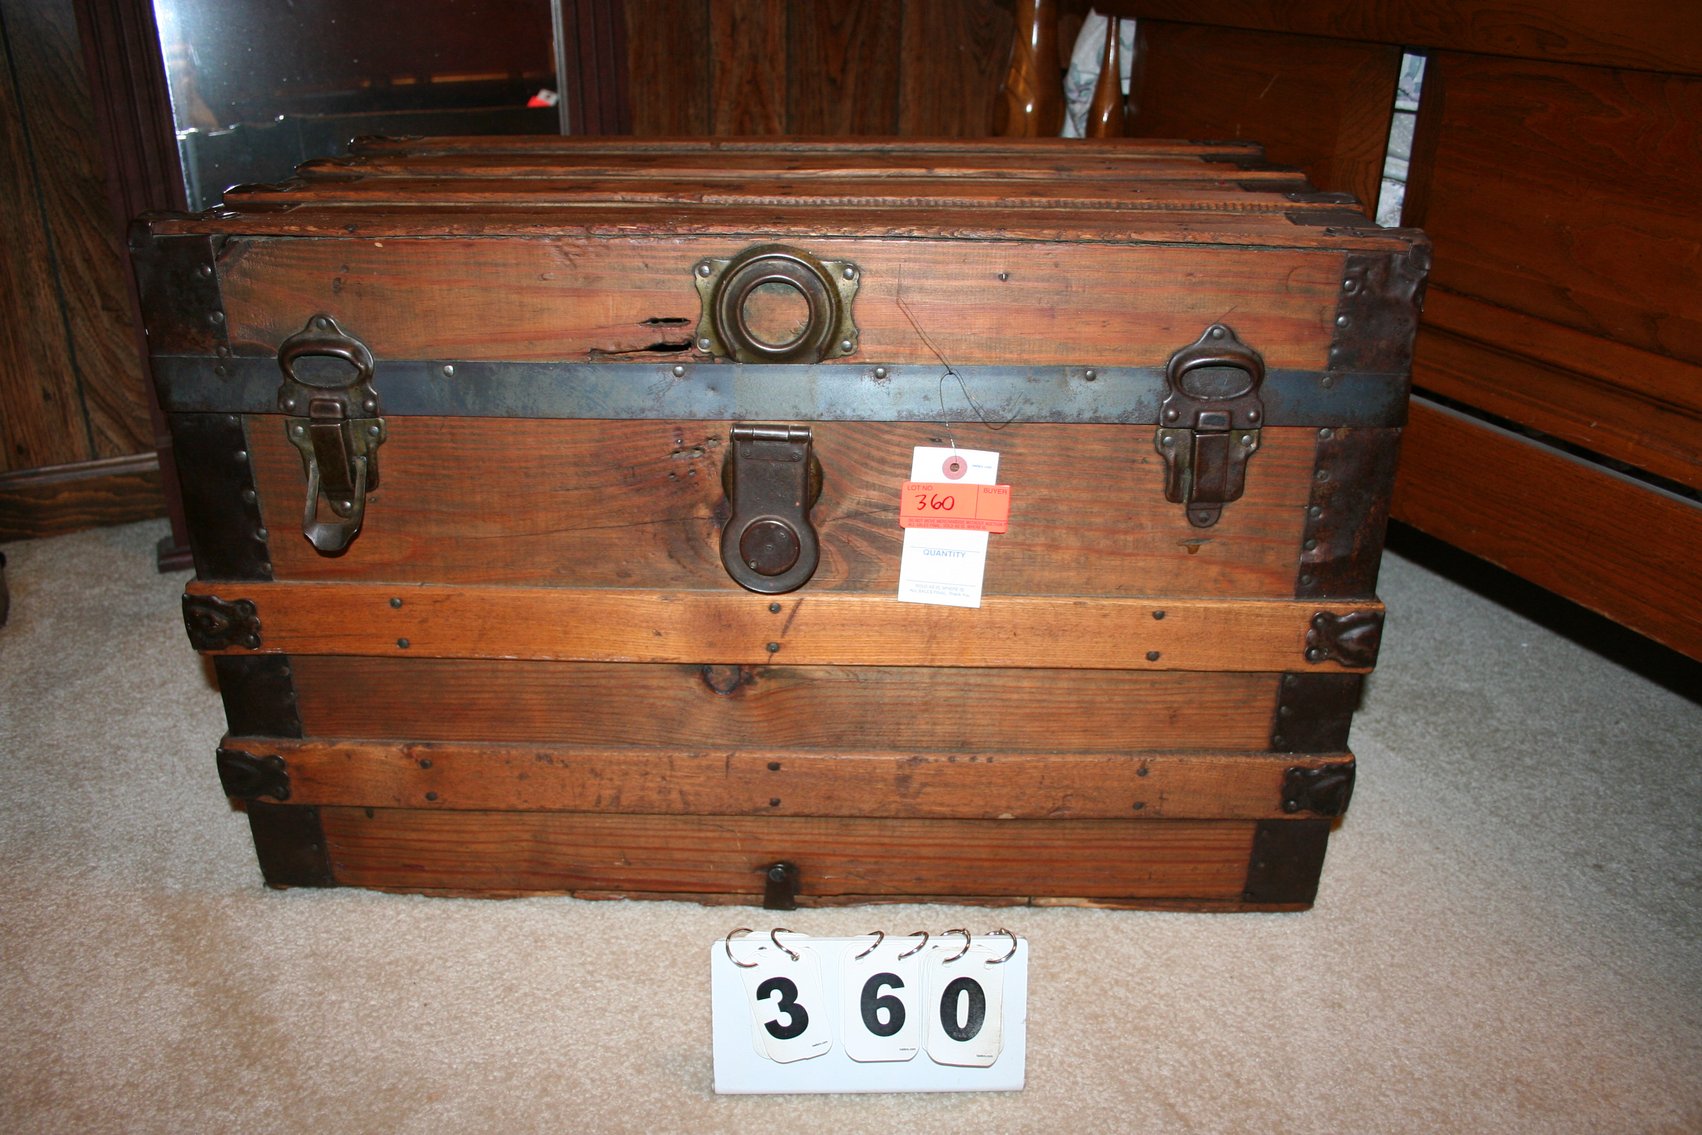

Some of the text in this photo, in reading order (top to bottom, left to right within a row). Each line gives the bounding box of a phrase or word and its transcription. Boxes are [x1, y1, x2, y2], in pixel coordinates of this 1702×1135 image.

[914, 493, 955, 511] 360
[923, 548, 966, 558] QUANTITY
[756, 972, 987, 1042] 3 6 0
